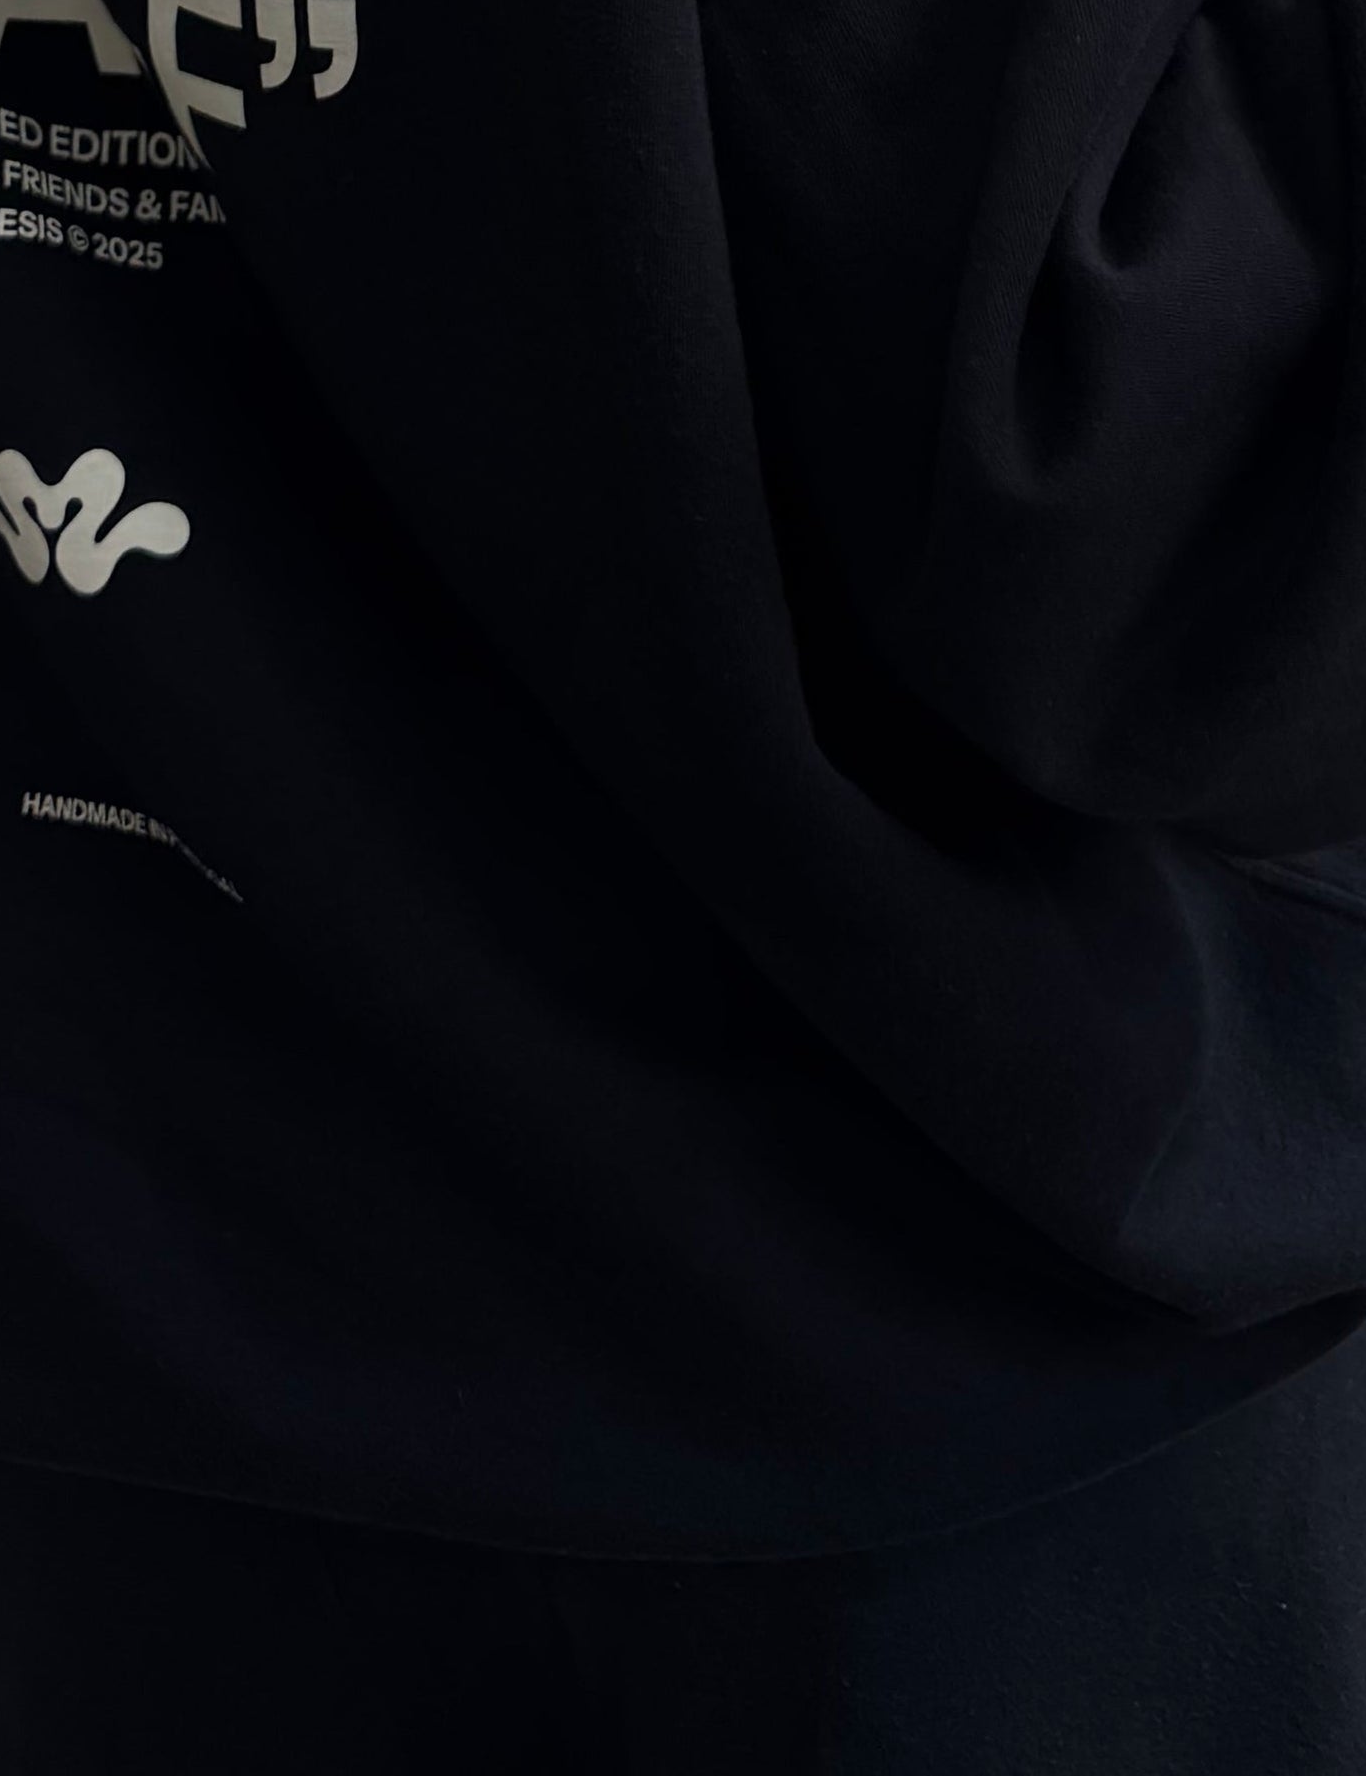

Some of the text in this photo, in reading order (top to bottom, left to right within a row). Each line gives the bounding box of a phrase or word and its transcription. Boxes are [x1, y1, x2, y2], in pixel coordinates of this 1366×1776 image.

[0, 159, 130, 219] FRIENDS
[134, 187, 163, 223] &
[92, 234, 165, 271] 2025
[21, 791, 149, 836] HANDMADE
